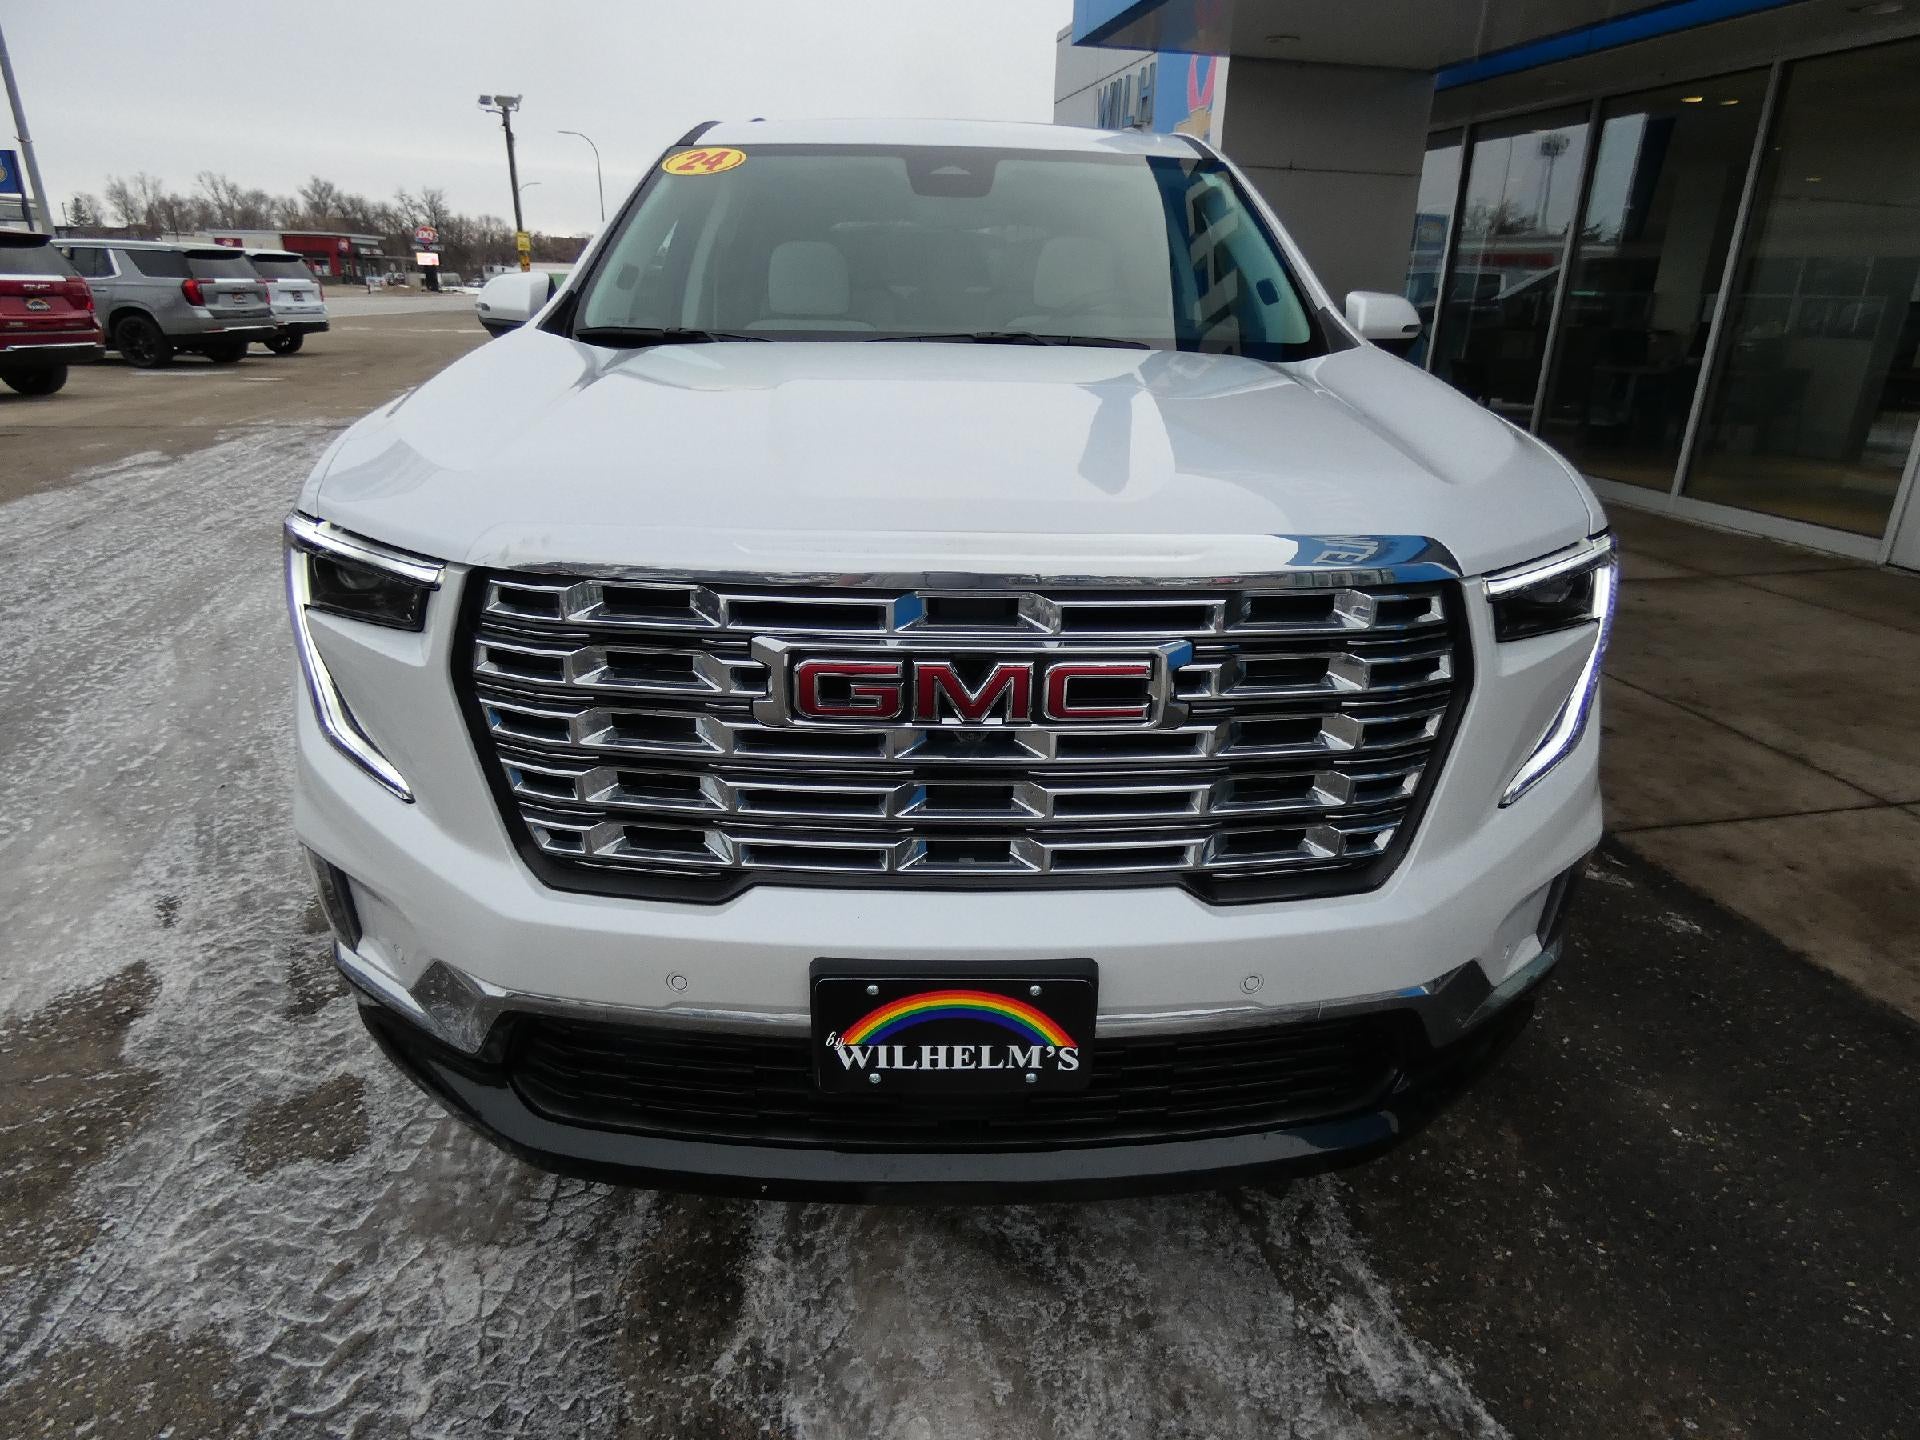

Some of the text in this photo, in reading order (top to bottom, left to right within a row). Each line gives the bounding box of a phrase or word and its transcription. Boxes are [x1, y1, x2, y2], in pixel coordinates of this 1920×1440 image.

[676, 151, 731, 171] 24
[794, 660, 1152, 724] GMC
[826, 1031, 1079, 1071] by WILHELM'S
